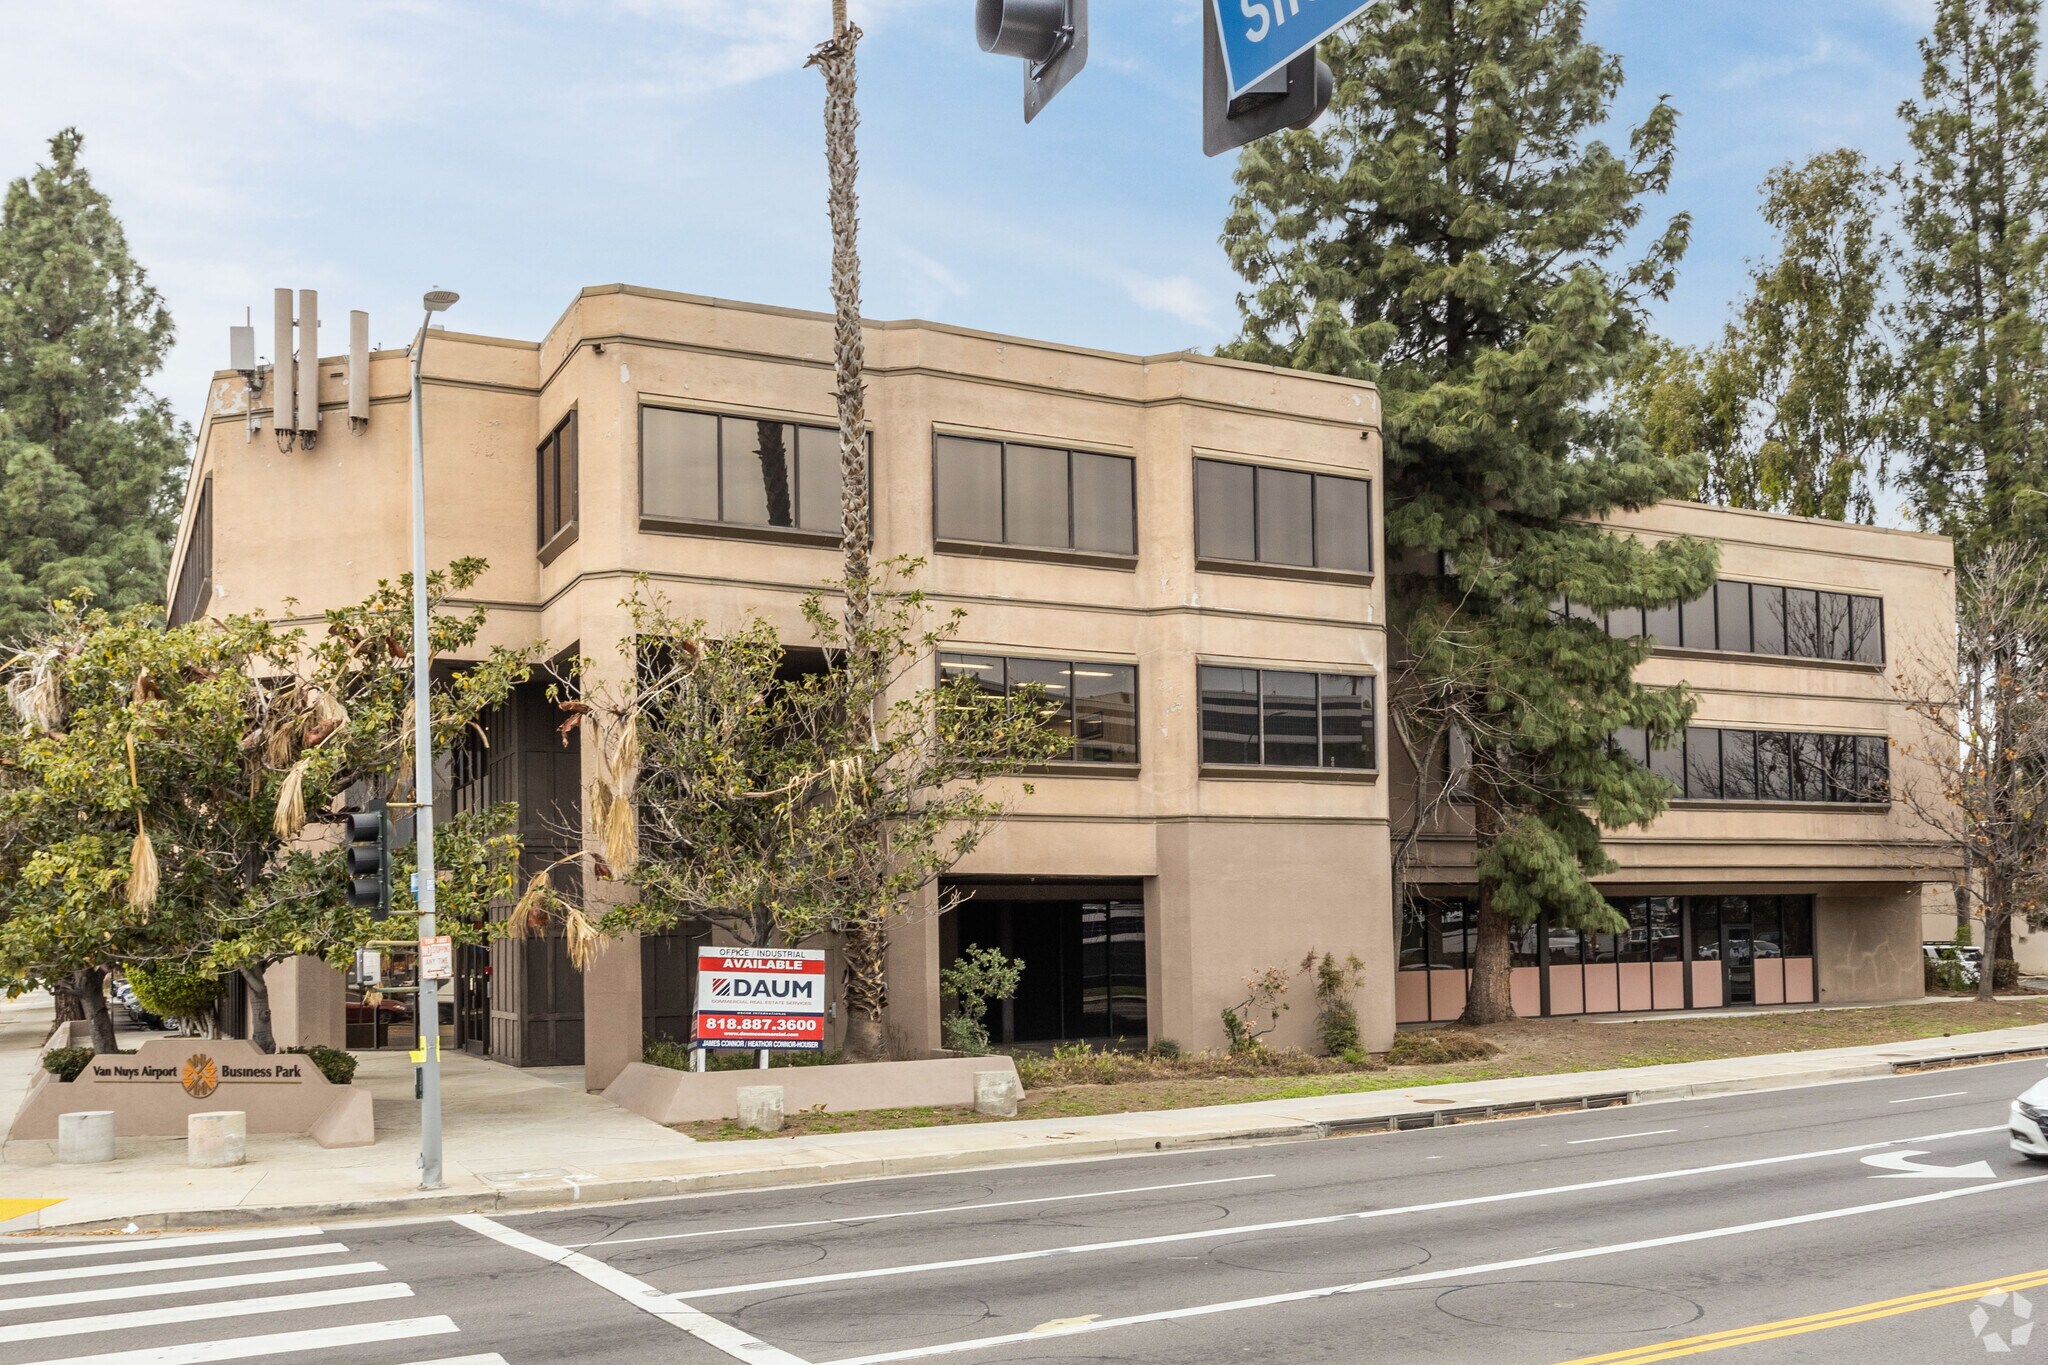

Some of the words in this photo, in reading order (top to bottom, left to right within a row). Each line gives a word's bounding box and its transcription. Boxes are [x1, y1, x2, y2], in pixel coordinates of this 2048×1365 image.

[719, 948, 749, 957] OFFICE
[756, 950, 806, 959] INDUSTRIAL
[722, 959, 802, 970] AVAILABLE
[733, 979, 812, 998] DAUM
[706, 1018, 817, 1031] 818.887.3600
[93, 1066, 111, 1076] Van
[114, 1066, 139, 1079] Nuys
[141, 1066, 177, 1079] Airport
[222, 1065, 272, 1077] Business
[275, 1065, 302, 1077] Park
